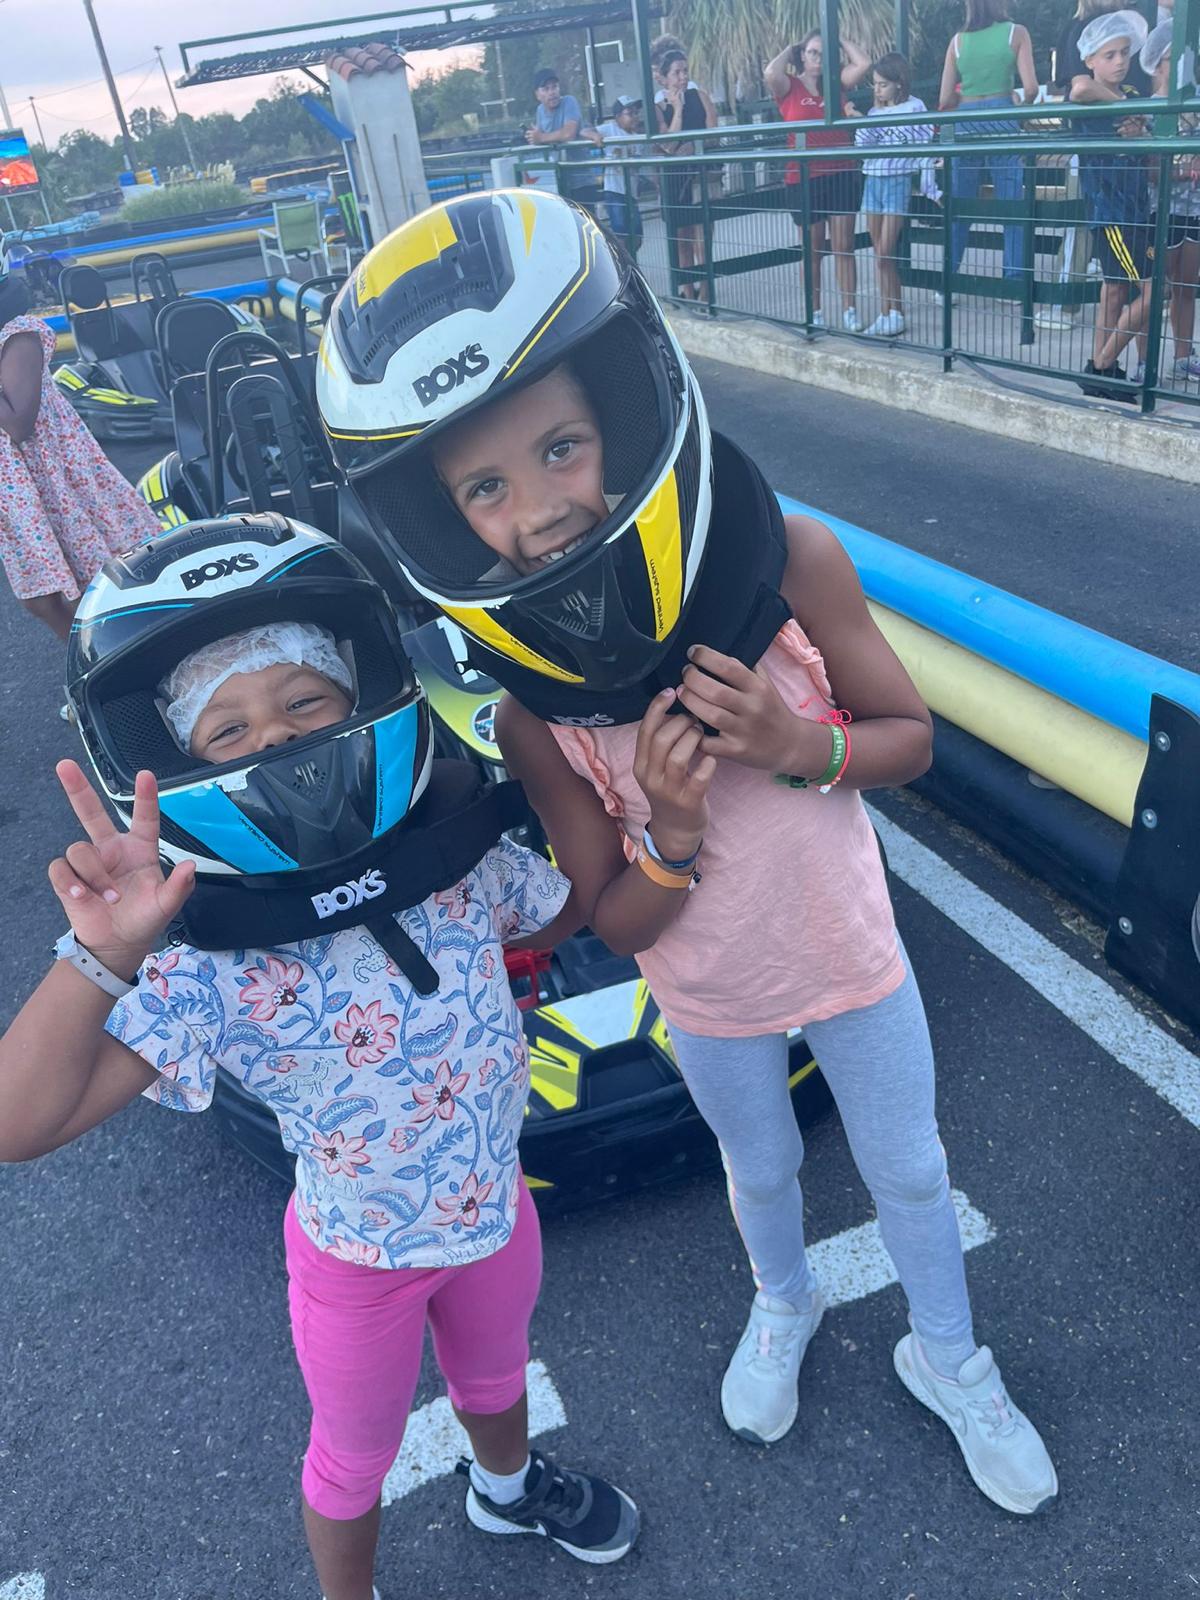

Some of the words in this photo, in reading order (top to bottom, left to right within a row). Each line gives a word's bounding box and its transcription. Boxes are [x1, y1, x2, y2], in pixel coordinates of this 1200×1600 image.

[412, 343, 490, 408] BOX'S
[180, 553, 259, 591] BOX'S
[310, 868, 387, 919] BOX'S
